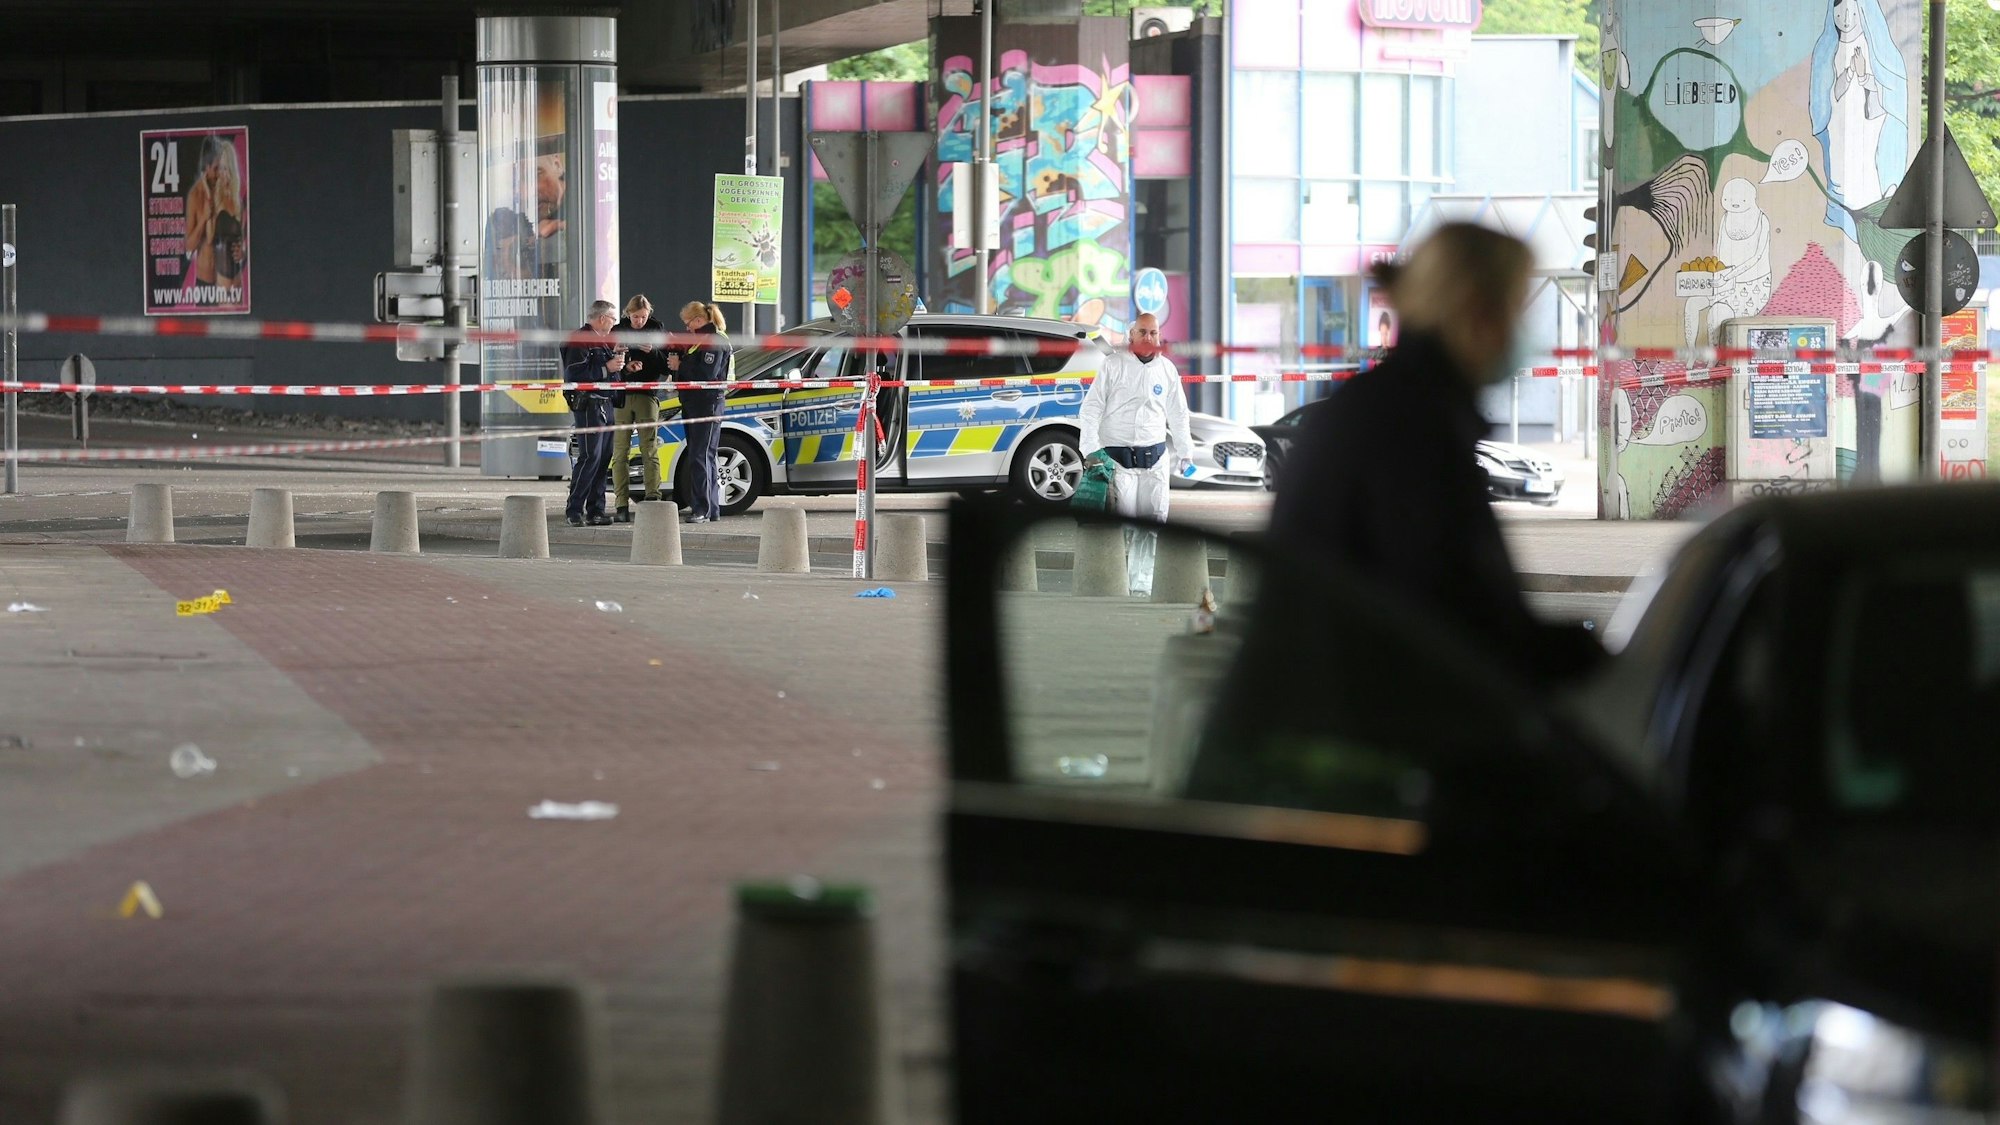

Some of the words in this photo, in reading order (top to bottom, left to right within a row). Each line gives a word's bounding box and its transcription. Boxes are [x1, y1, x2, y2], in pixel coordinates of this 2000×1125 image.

[150, 141, 180, 194] 24
[720, 188, 779, 197] VOGELSPINNEN
[149, 197, 184, 215] STUNDEN
[492, 278, 560, 297] ERFOLGREICHERE
[715, 281, 754, 289] 25.05.25
[154, 284, 243, 305] www.novum.tv
[715, 288, 754, 297] Sonntag
[1747, 365, 1804, 374] POLIZEIABSPERRUNG
[1811, 364, 1862, 373] POLIZEIABSPERRUNG
[789, 408, 837, 428] POLIZEI
[1660, 407, 1701, 436] Pinto!
[177, 603, 192, 614] 32
